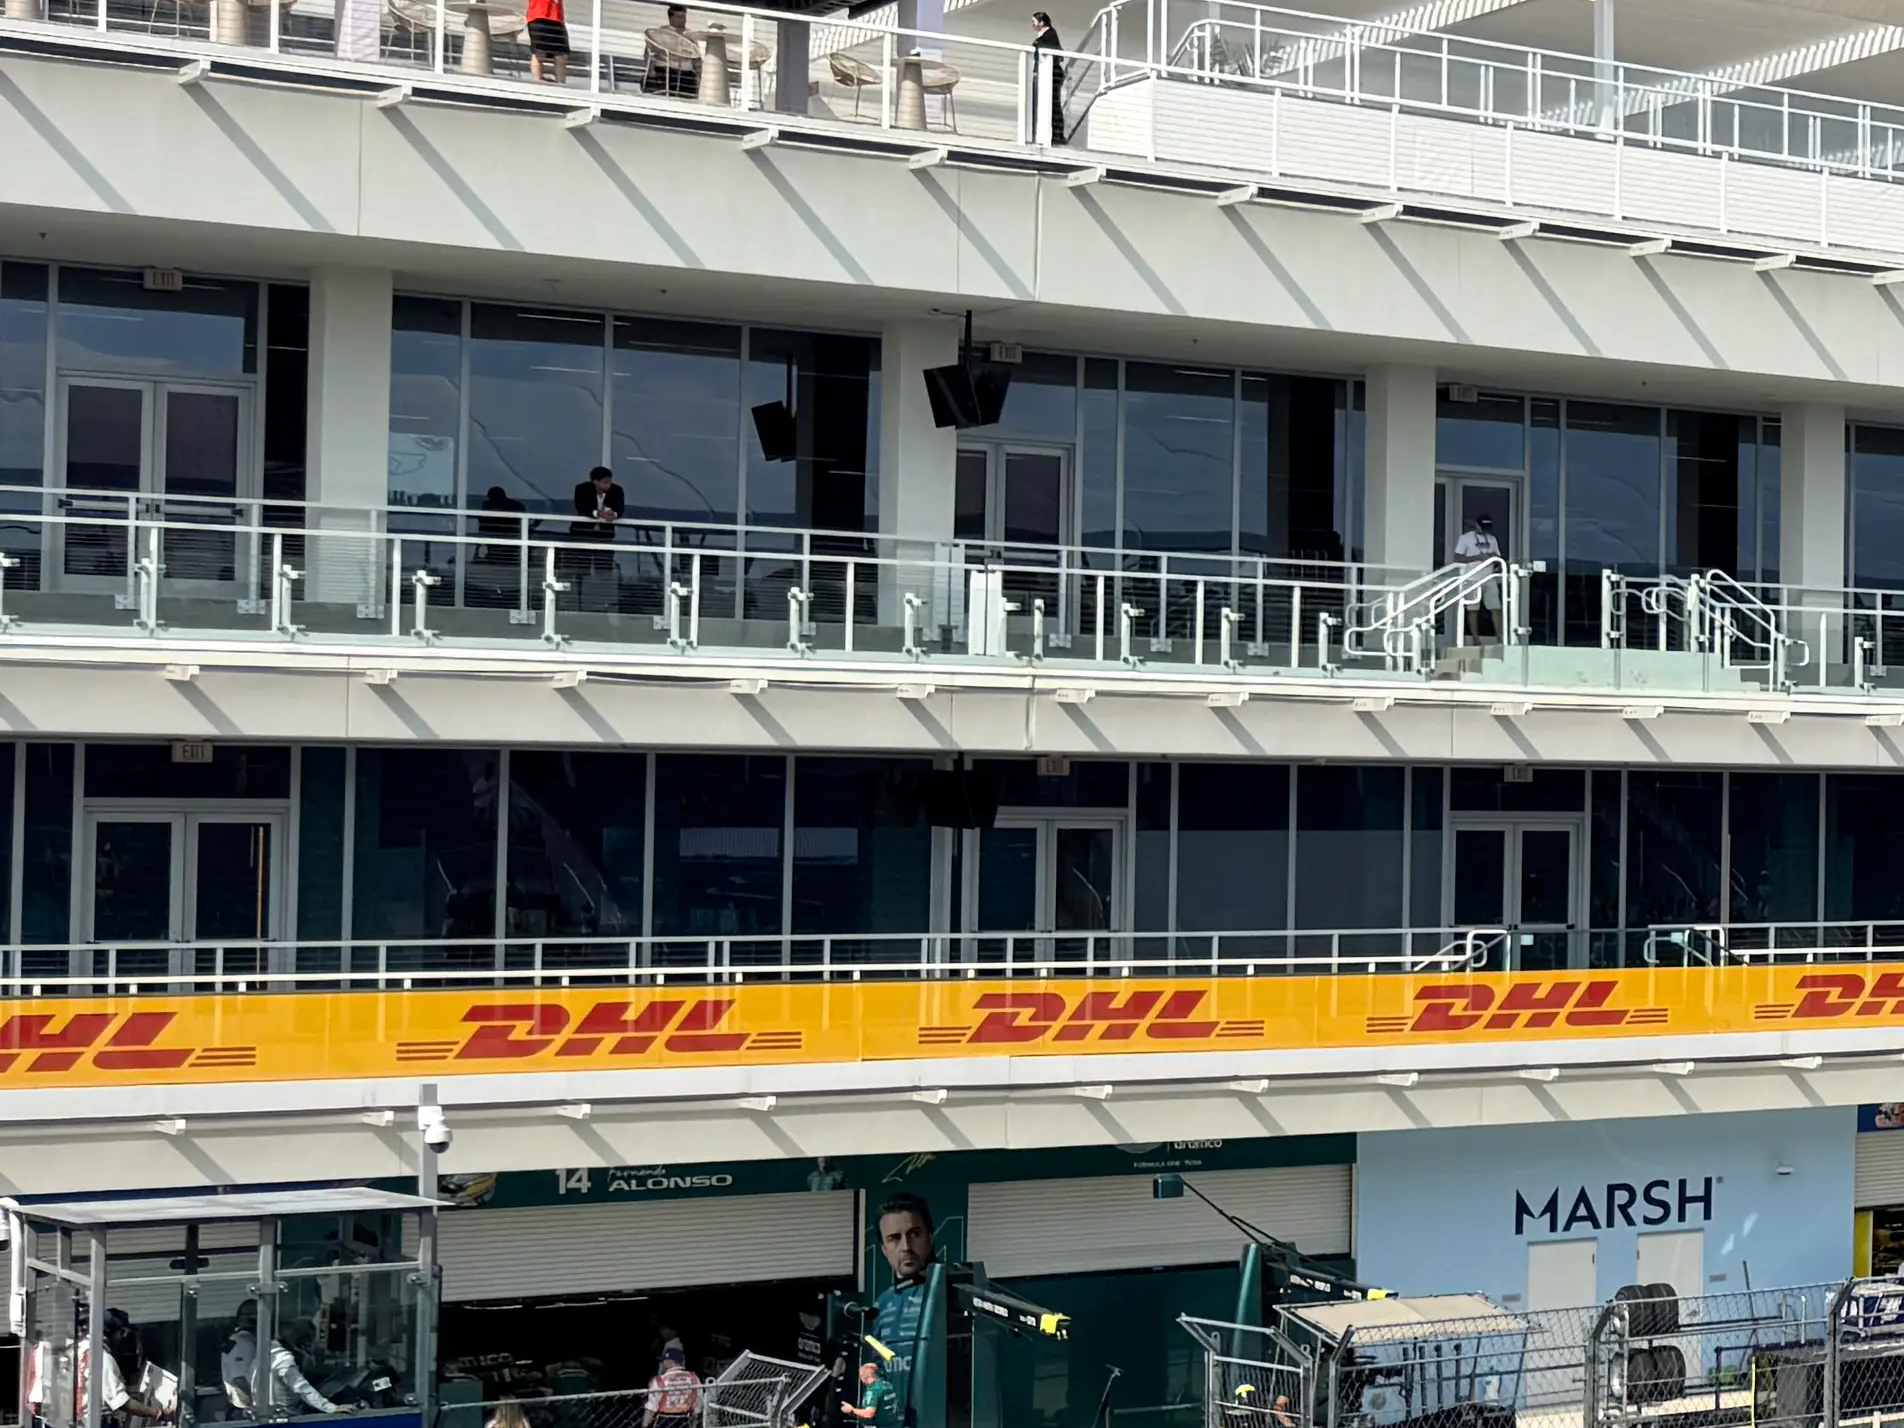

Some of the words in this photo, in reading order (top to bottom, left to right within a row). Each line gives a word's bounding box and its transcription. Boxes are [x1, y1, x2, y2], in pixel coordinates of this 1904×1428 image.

[455, 999, 753, 1060] DHL
[966, 990, 1221, 1044] DHL
[1410, 980, 1631, 1033] DHL
[555, 1167, 591, 1196] 14
[608, 1173, 733, 1192] ALONSO
[1514, 1176, 1714, 1235] MARSH
